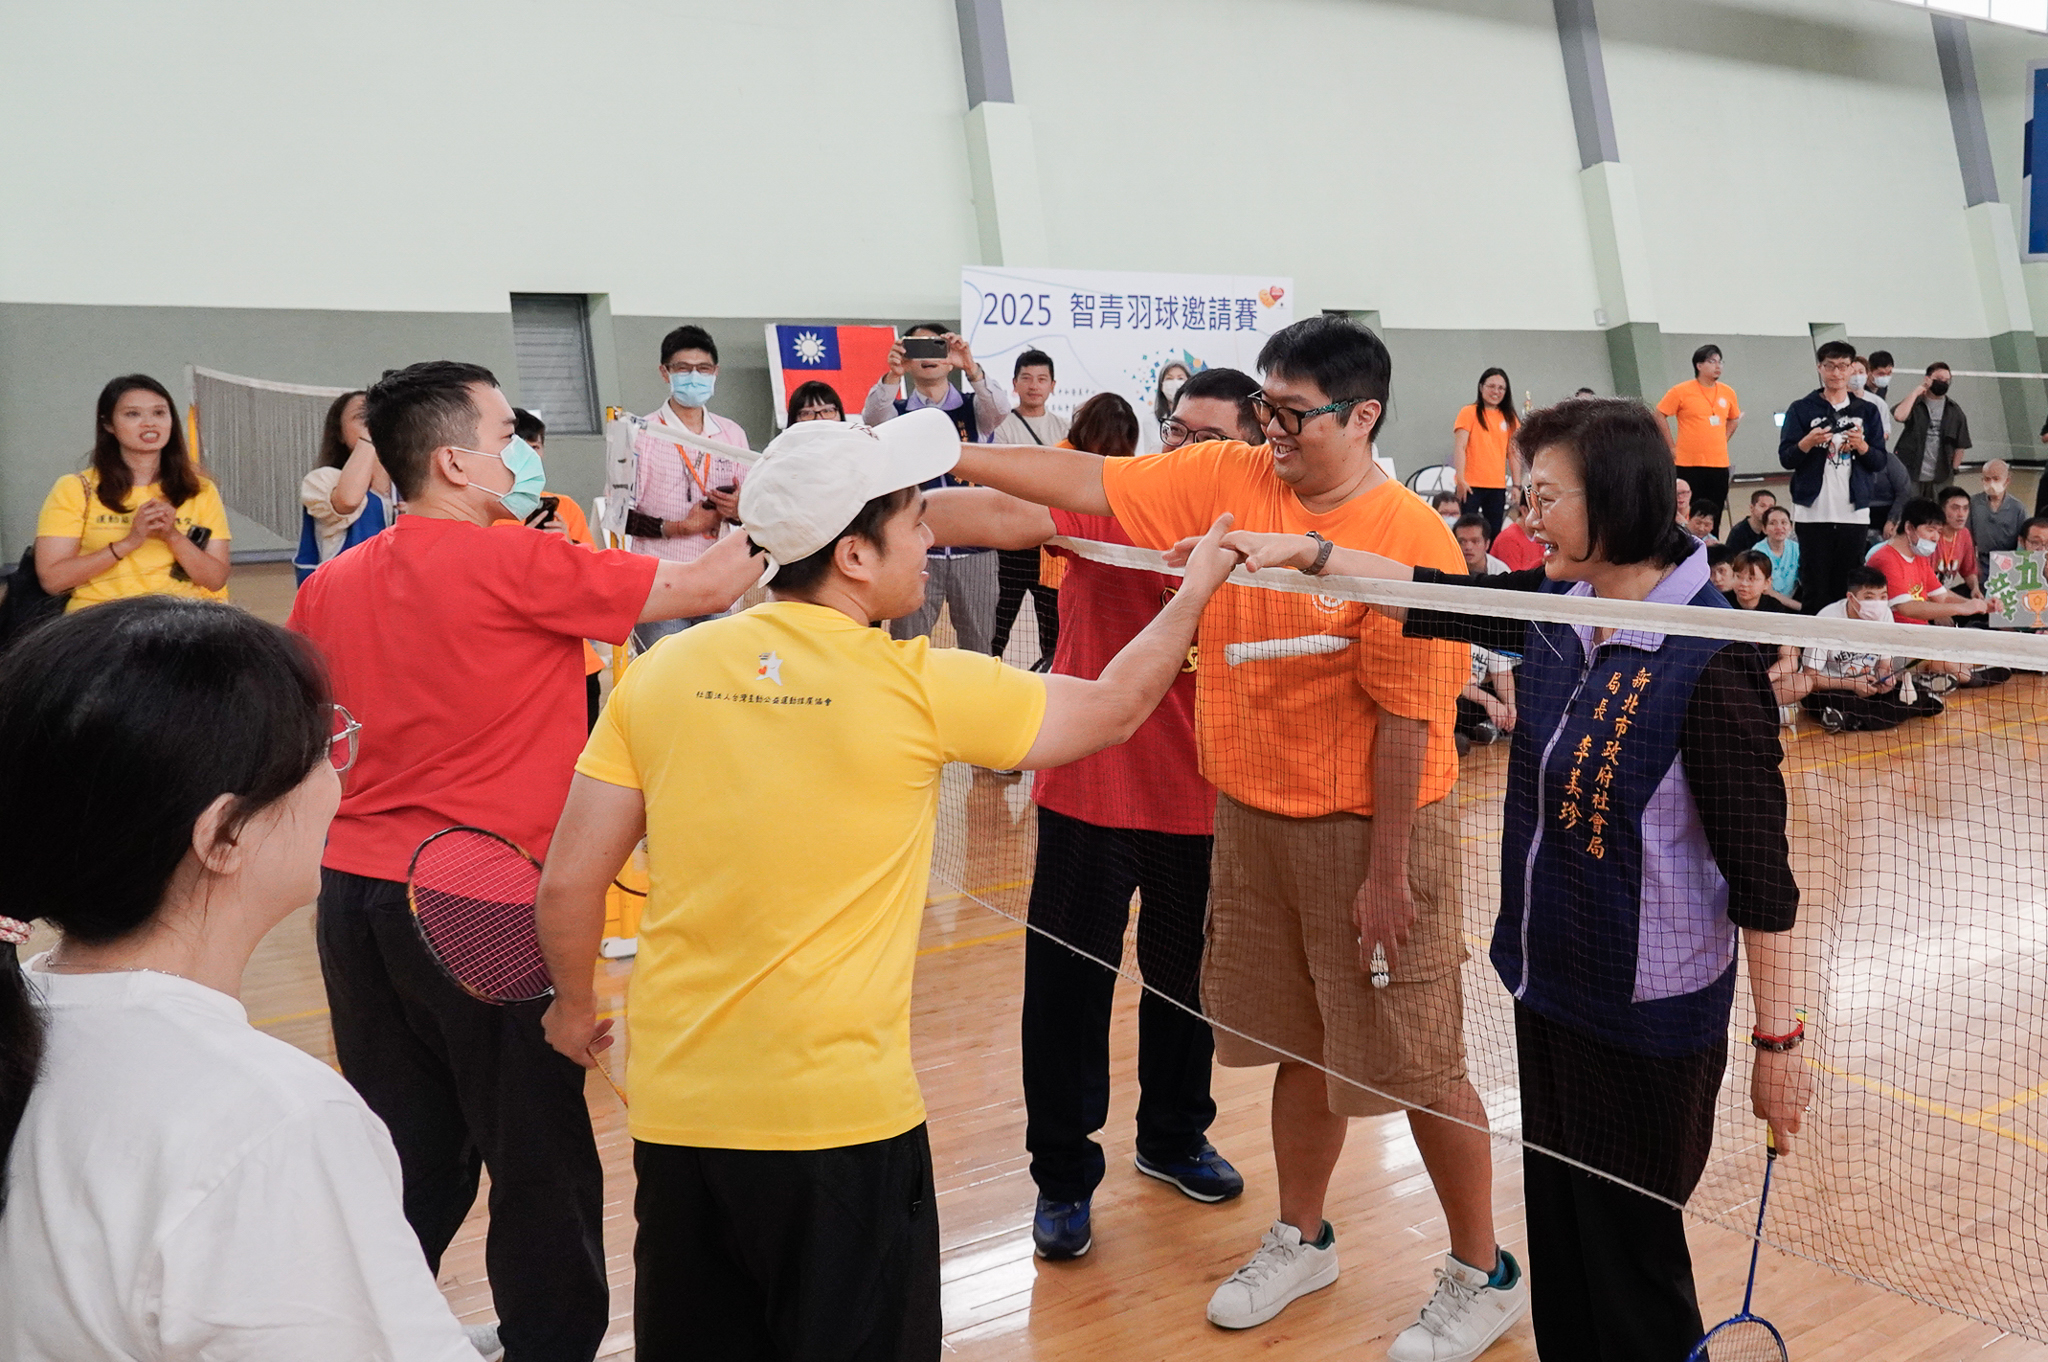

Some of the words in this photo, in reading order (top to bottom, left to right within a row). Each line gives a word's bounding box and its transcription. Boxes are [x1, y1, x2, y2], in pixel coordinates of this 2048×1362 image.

[983, 292, 1052, 327] 2025
[1070, 292, 1258, 332] 智青羽球邀請賽
[1593, 671, 1622, 721] 局長
[1586, 666, 1652, 859] 新北市政府社會局
